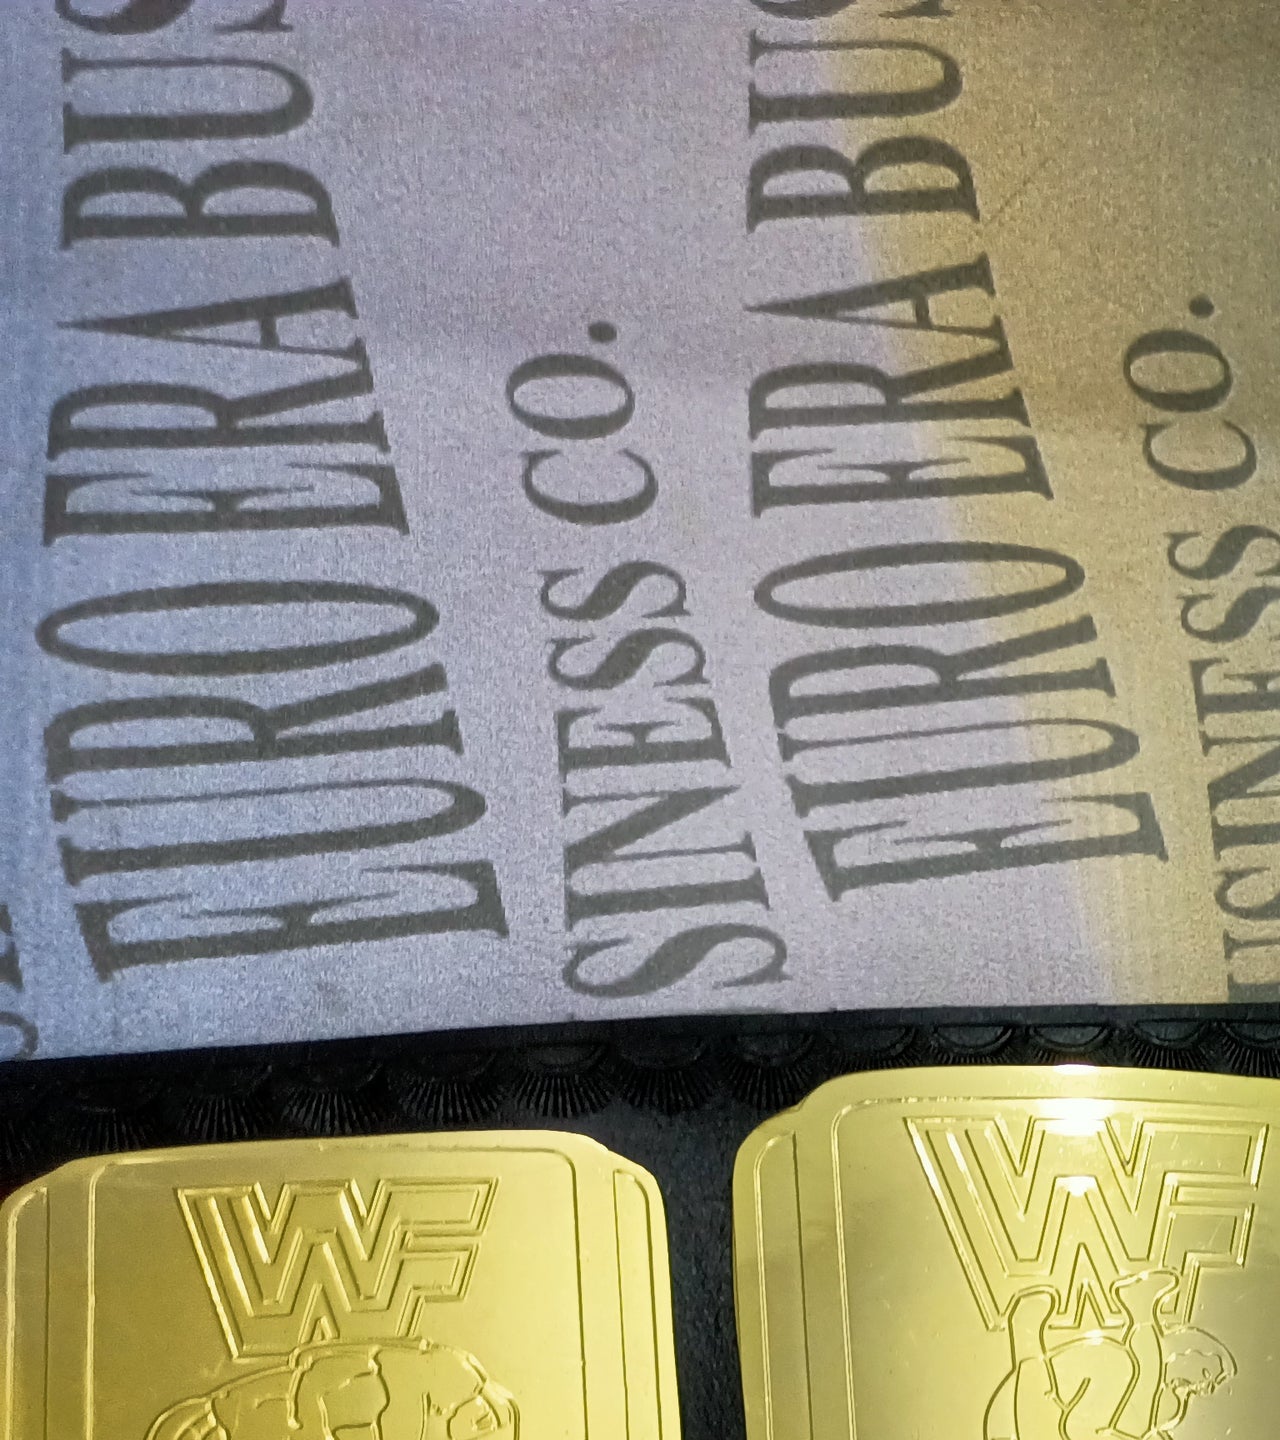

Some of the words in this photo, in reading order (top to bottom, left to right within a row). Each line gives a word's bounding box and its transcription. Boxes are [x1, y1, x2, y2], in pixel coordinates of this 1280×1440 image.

[42, 277, 410, 546] ERA
[505, 320, 658, 525] CO.
[745, 252, 1054, 518] ERA
[1122, 295, 1257, 491] CO.
[36, 580, 510, 981] EURO
[754, 540, 1169, 902] EURO
